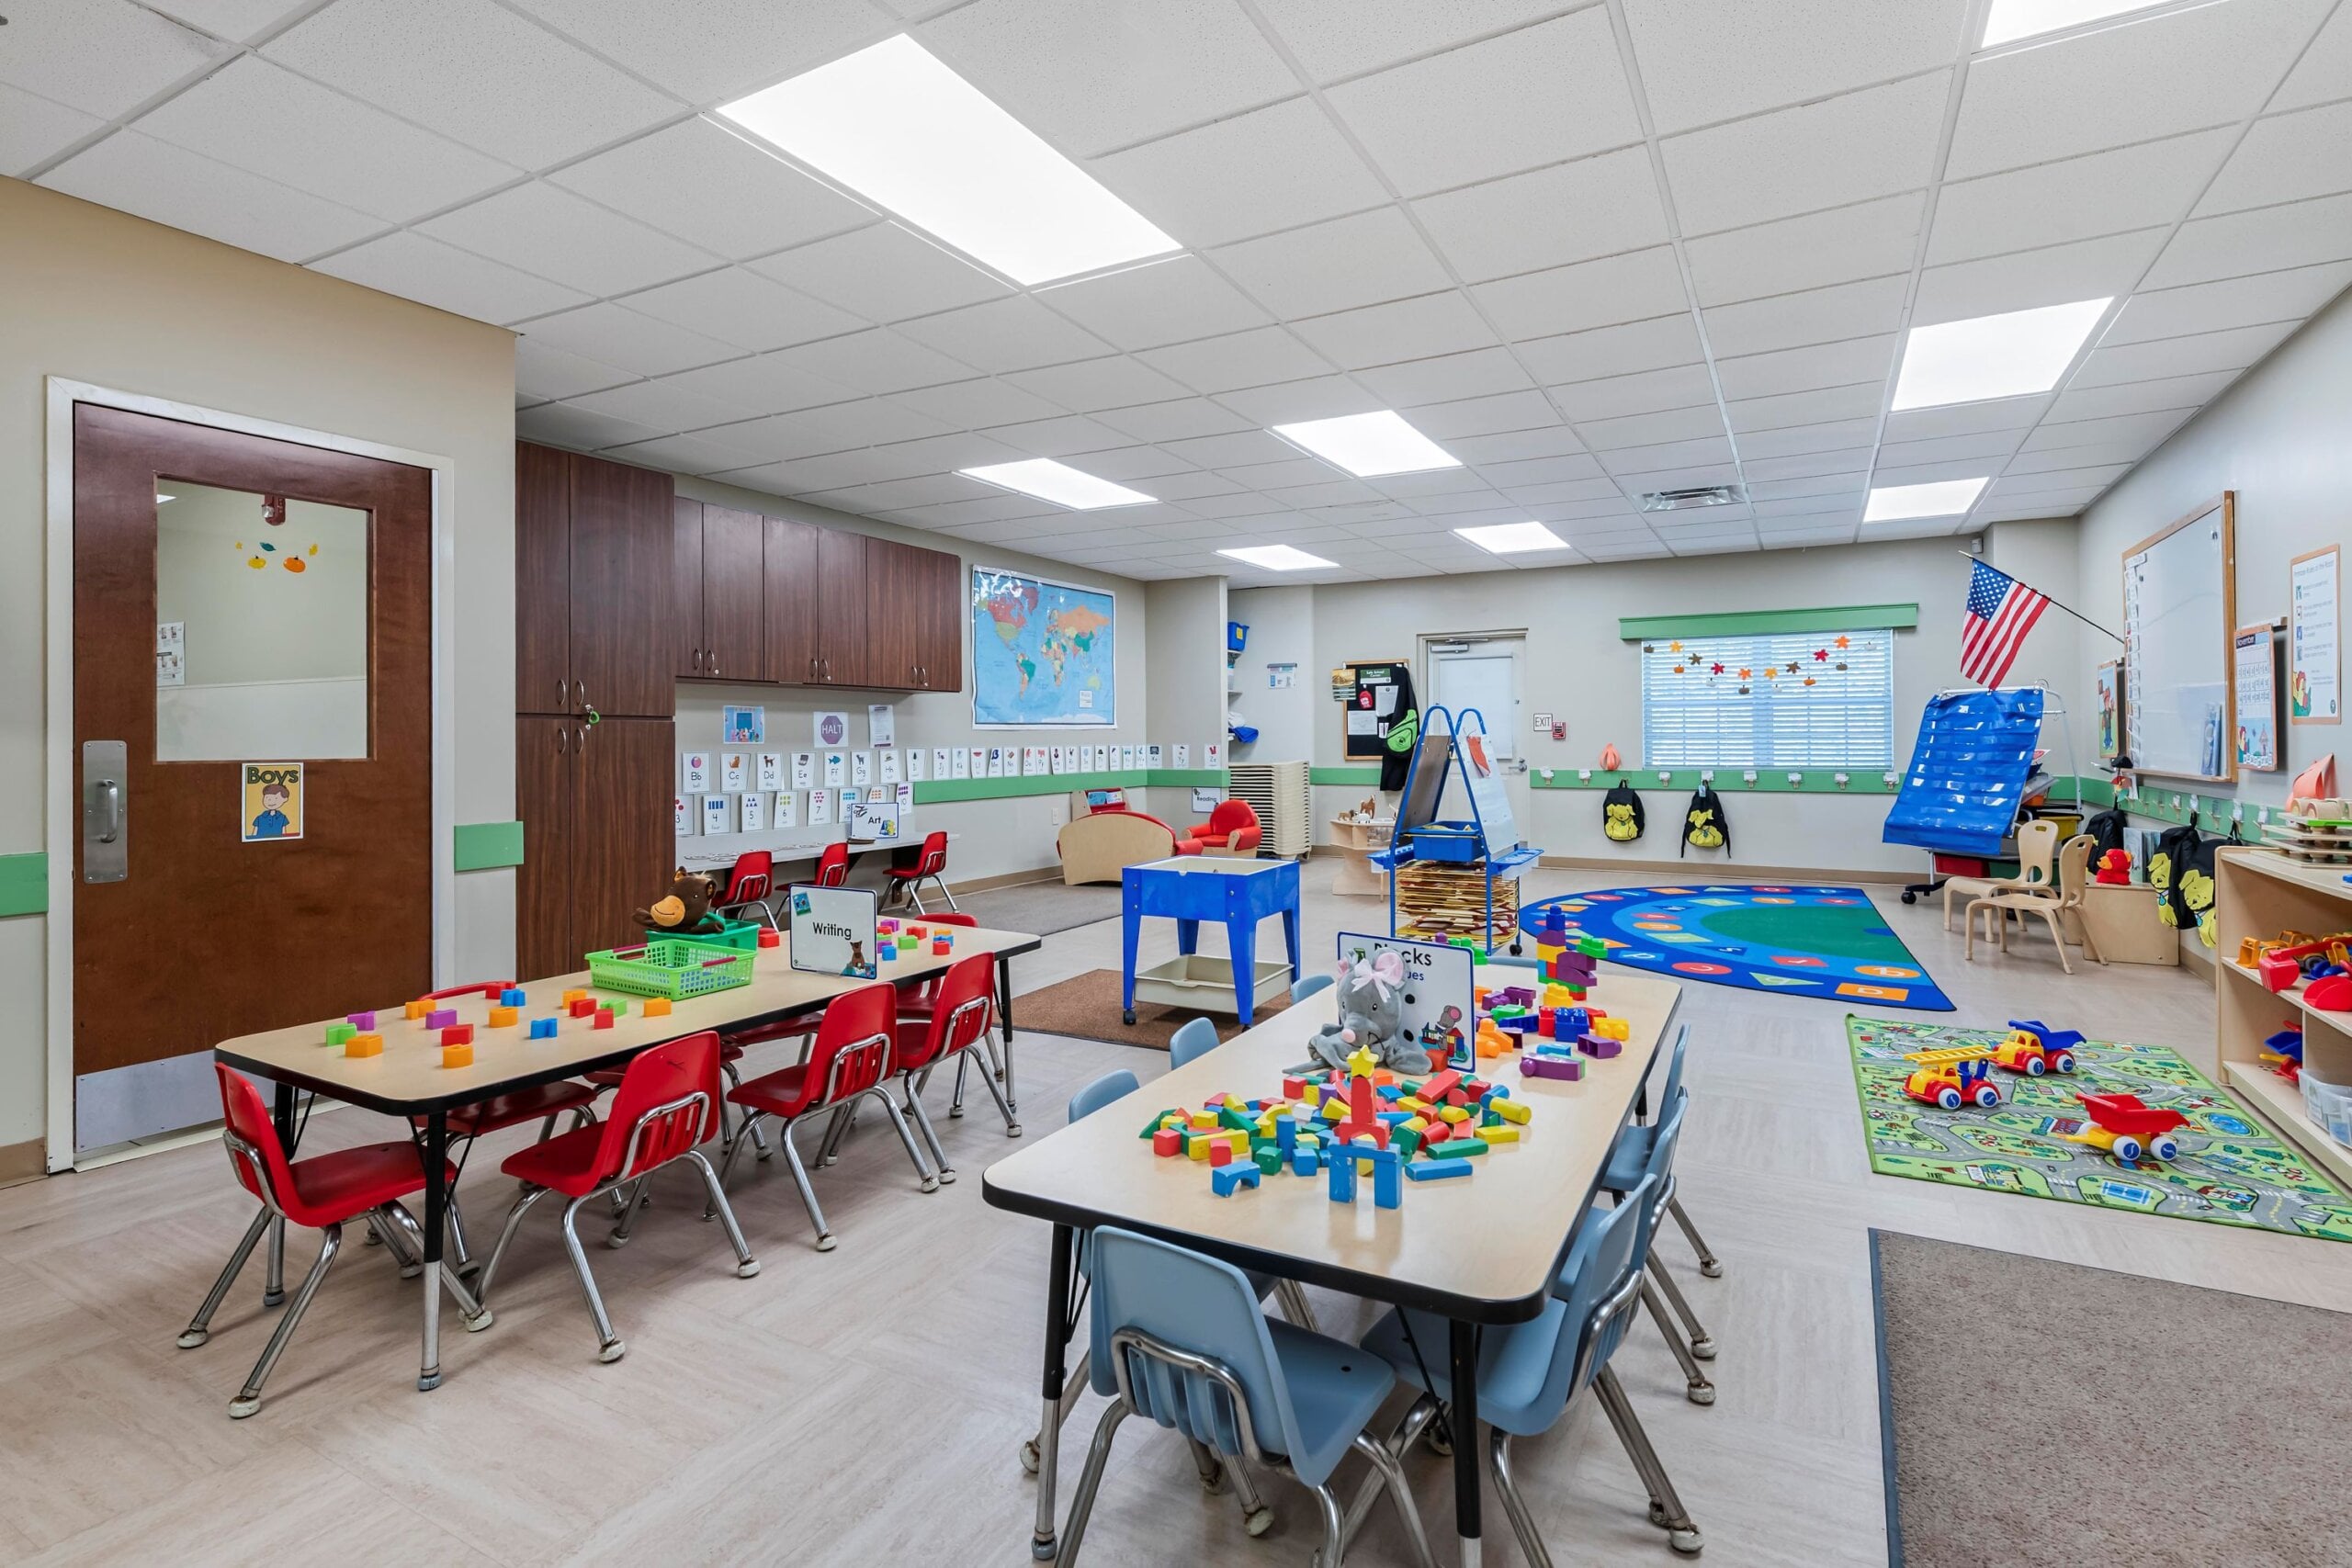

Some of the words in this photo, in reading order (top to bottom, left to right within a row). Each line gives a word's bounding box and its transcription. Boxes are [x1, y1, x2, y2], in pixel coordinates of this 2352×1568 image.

[1535, 716, 1551, 727] EXIT
[821, 724, 842, 735] HALT
[247, 766, 299, 785] Boys
[729, 772, 740, 780] Cc
[763, 771, 775, 780] Dd
[798, 770, 807, 778] Ee
[856, 766, 866, 777] Gg
[691, 772, 702, 781] Bb
[749, 810, 754, 819] 5
[783, 809, 787, 818] 6
[816, 806, 821, 814] 7
[675, 814, 681, 823] 3
[712, 813, 718, 822] 4
[812, 921, 852, 940] Writing
